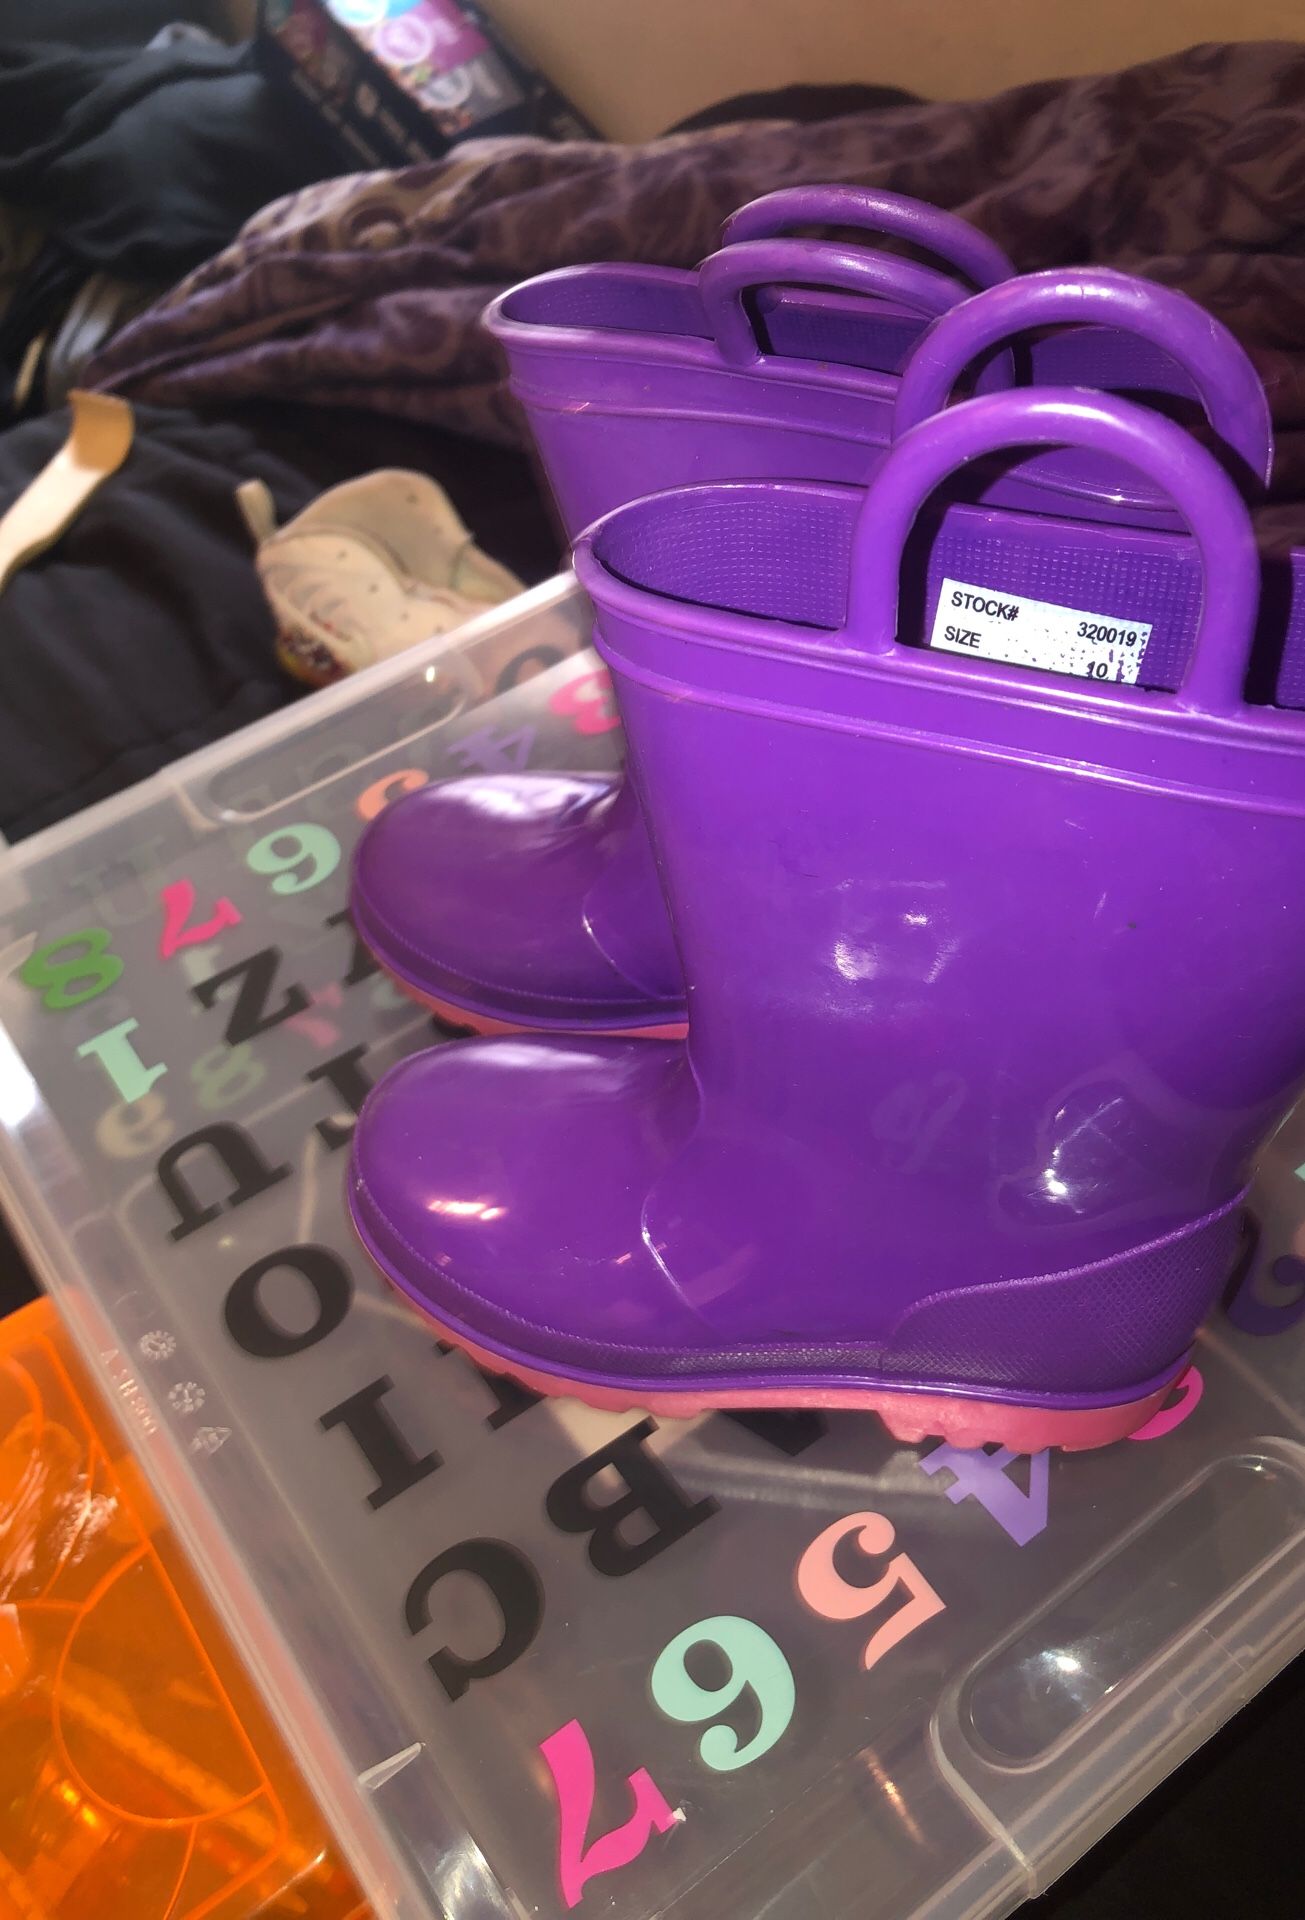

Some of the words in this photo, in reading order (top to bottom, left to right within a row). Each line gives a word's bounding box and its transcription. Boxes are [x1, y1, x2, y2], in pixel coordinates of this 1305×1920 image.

[944, 625, 982, 649] SIZE
[950, 591, 1019, 621] STOCK#
[1077, 621, 1137, 647] 320019
[19, 926, 125, 1010] 8
[158, 877, 243, 961] 7
[190, 944, 312, 1047] Z
[76, 1016, 168, 1104] 1
[156, 1119, 293, 1243] U
[223, 1242, 356, 1360] O
[318, 1373, 446, 1511] I
[545, 1415, 723, 1578] B
[403, 1535, 547, 1704] C
[796, 1510, 947, 1671] 5
[538, 1717, 680, 1909] 7
